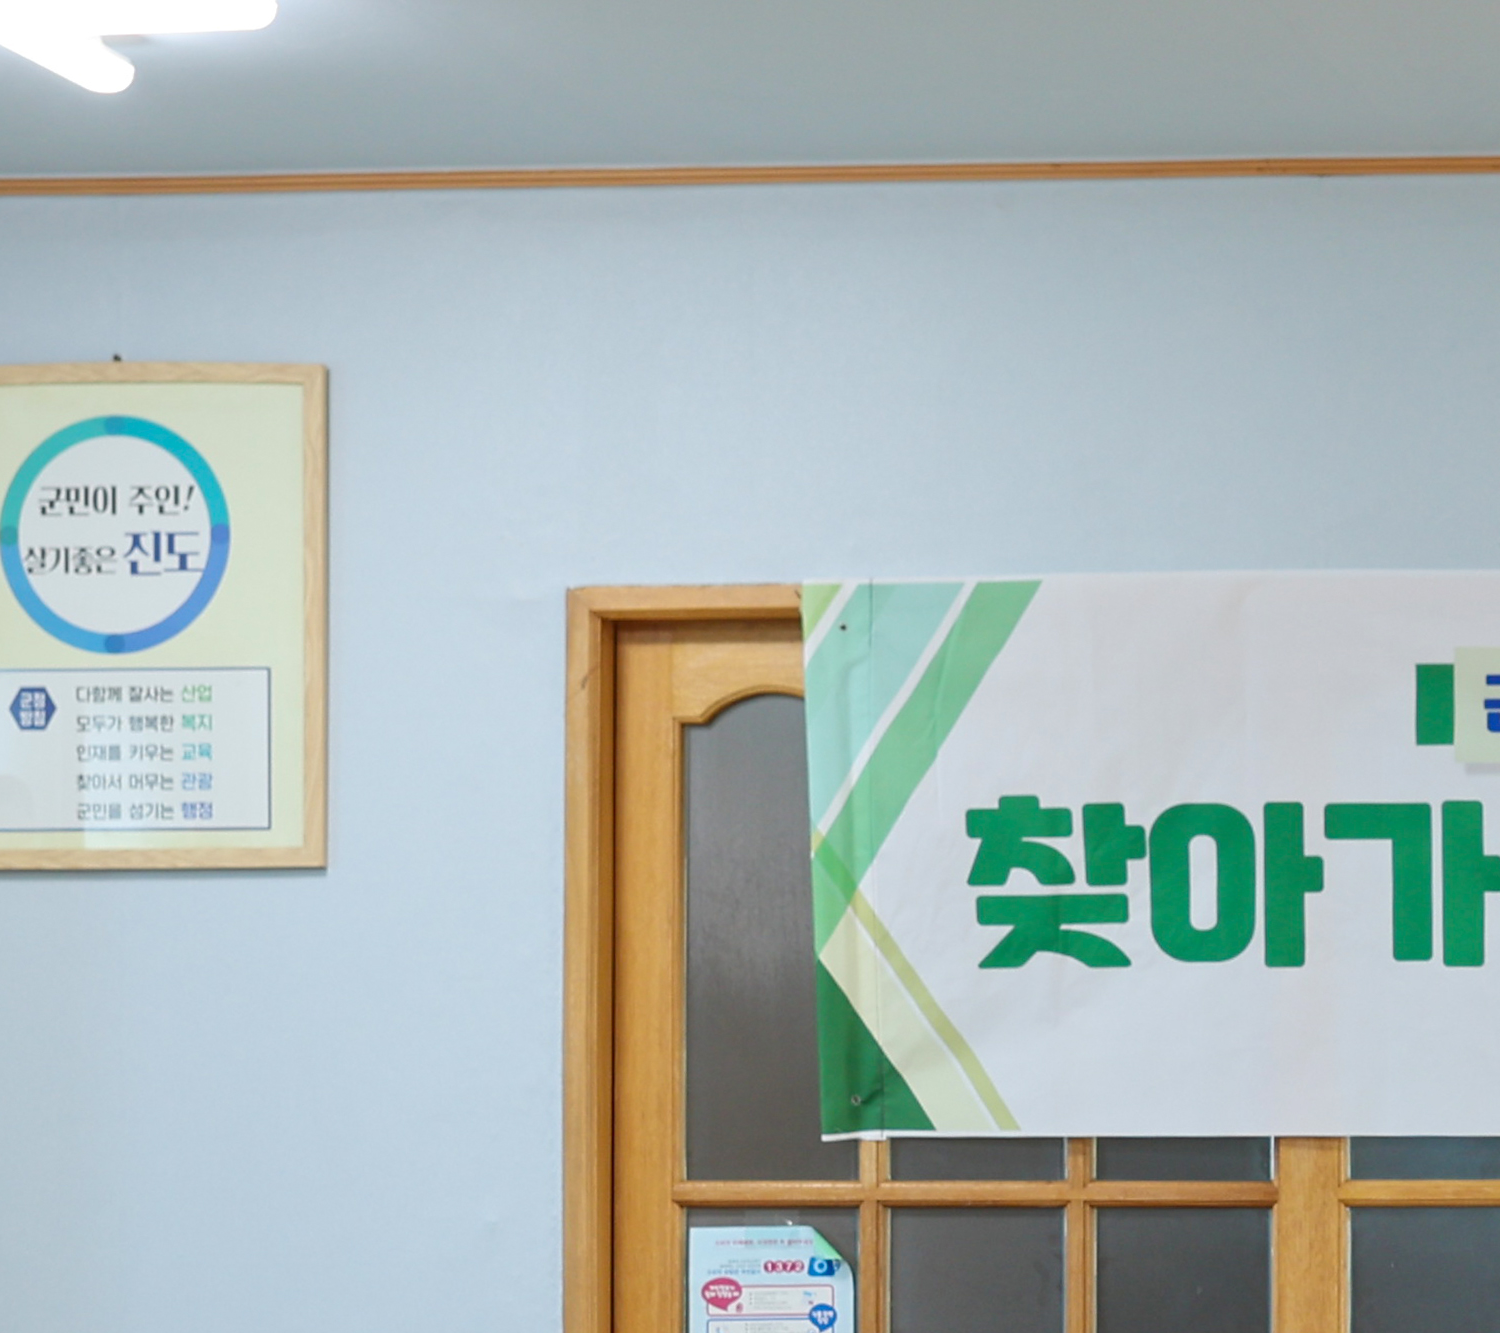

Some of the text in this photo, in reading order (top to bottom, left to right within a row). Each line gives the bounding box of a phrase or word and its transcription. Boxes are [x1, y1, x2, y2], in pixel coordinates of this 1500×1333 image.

[38, 484, 196, 516] 군민이 주인!
[25, 530, 205, 577] 살기좋은 진도
[76, 685, 213, 702] 다함께 잘사는 산업
[76, 714, 213, 732] 모두가 행복한 복지
[76, 743, 213, 762] 인재를 키우는 교육
[77, 772, 213, 790] 찾아서 머무는 관광
[77, 802, 213, 820] 군민을 섬기는 행정
